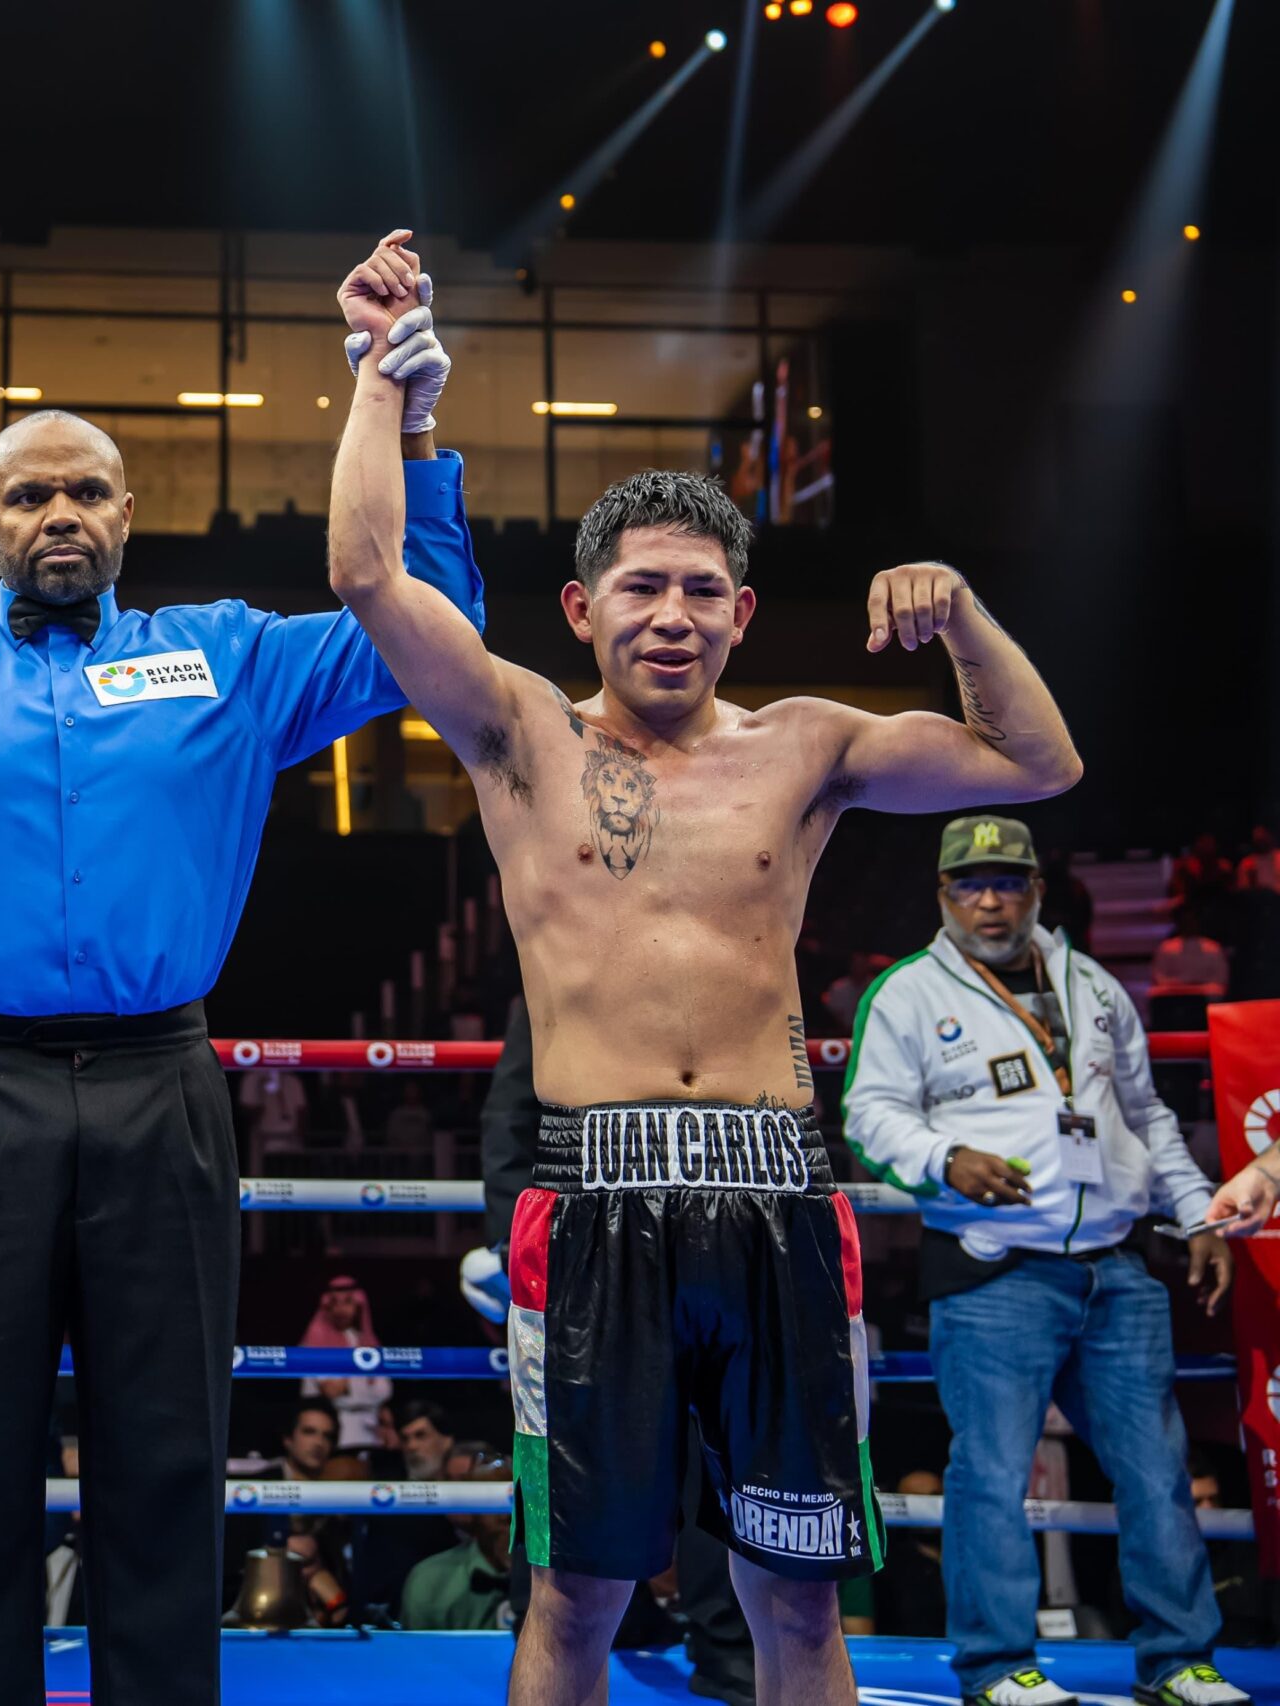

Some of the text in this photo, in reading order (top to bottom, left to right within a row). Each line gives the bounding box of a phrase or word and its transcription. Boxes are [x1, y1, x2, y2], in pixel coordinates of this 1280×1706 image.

[145, 662, 204, 677] RIYADH
[150, 672, 208, 685] SEASON
[582, 1107, 809, 1192] JUAN CARLOS
[742, 1484, 834, 1503] HECHO EN MEXICO
[730, 1492, 844, 1556] ORENDAY
